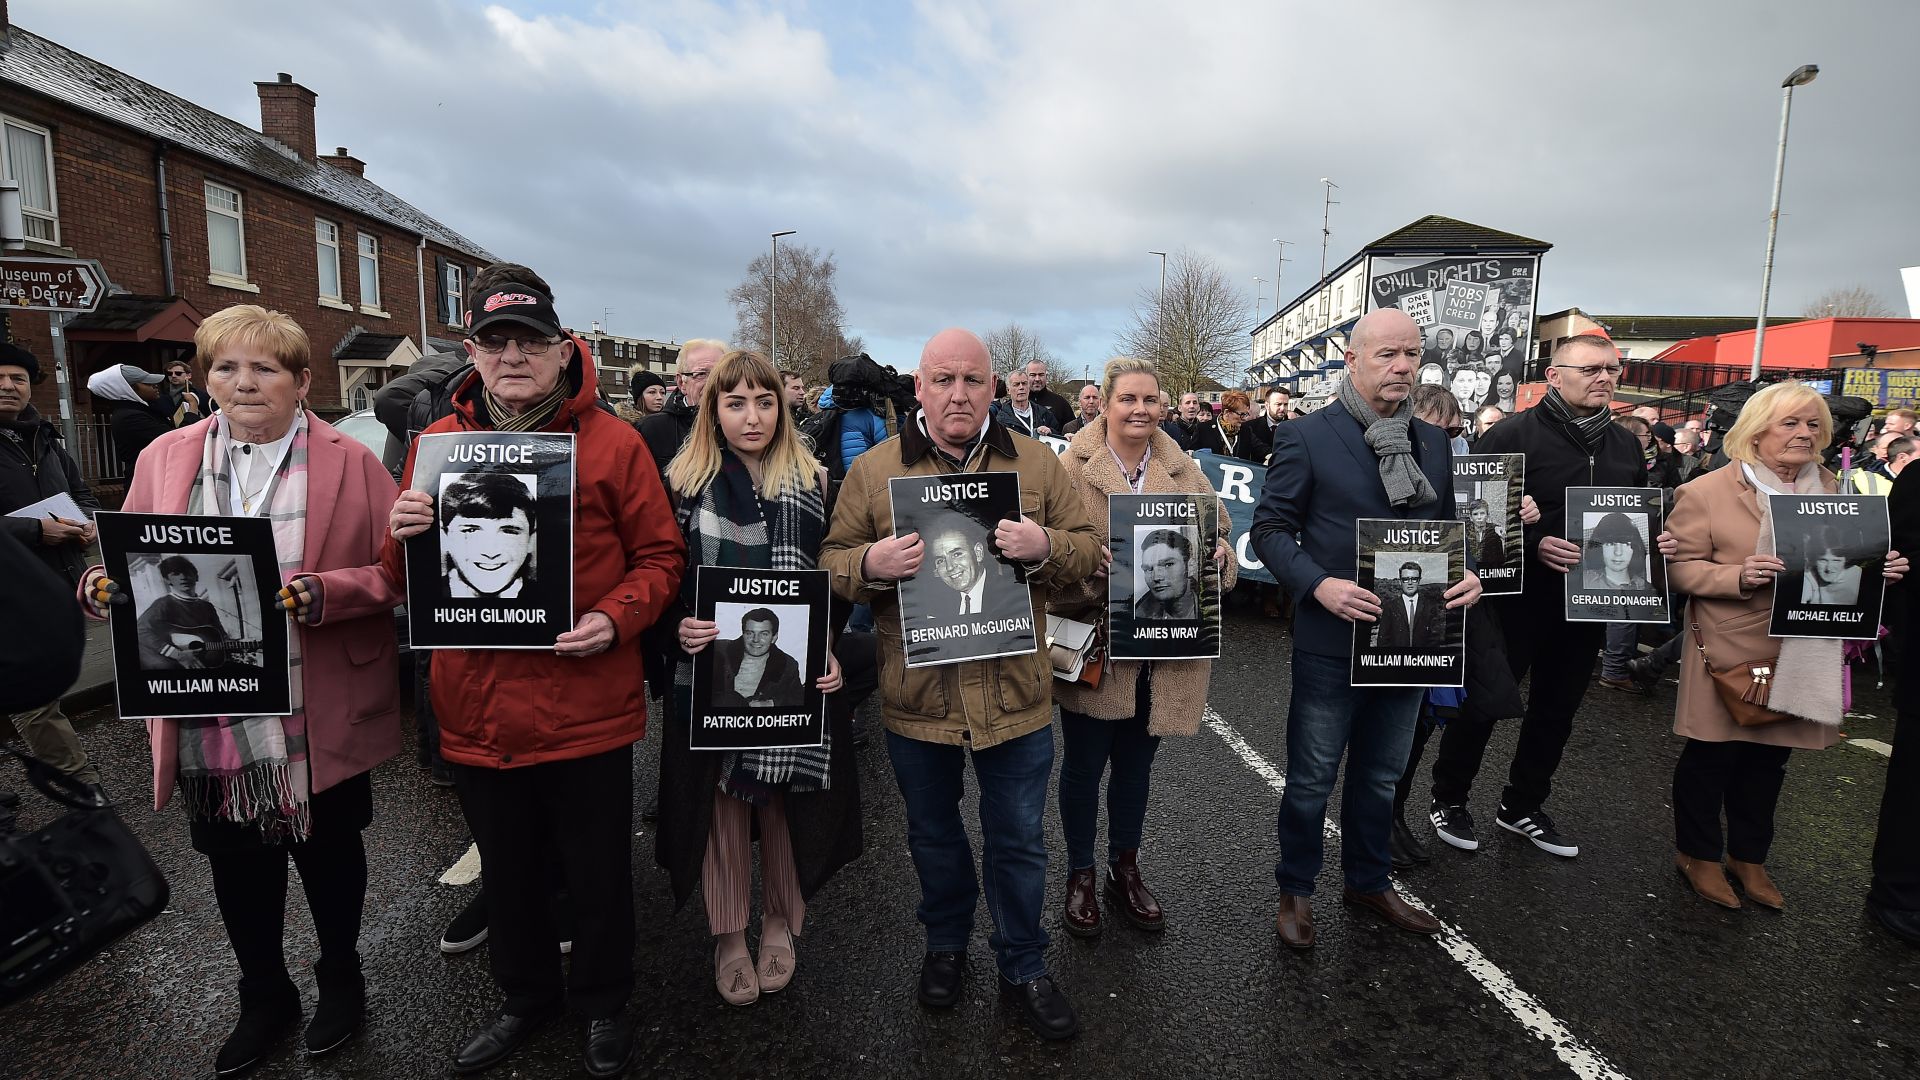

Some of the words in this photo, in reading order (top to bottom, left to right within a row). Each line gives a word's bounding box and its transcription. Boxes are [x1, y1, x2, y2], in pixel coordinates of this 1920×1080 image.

[0, 267, 52, 282] useum
[57, 270, 73, 283] of
[1375, 270, 1425, 297] CIVIL
[1427, 259, 1502, 289] RIGHTS
[31, 285, 73, 304] Derry
[1407, 293, 1429, 304] ONE
[1448, 284, 1485, 302] JOBS
[1407, 300, 1431, 312] MAN
[1450, 297, 1476, 311] NOT
[1410, 308, 1429, 319] ONE
[1415, 314, 1433, 326] OTE
[1445, 307, 1477, 321] CREED
[1846, 370, 1881, 384] FREE
[1842, 384, 1881, 395] DERRY
[447, 443, 533, 464] JUSTICE
[1453, 462, 1504, 476] JUSTICE
[920, 482, 989, 503] JUSTICE
[1590, 494, 1642, 507] JUSTICE
[1136, 502, 1196, 518] JUSTICE
[1796, 501, 1860, 516] JUSTICE
[139, 524, 234, 545] JUSTICE
[1383, 528, 1440, 545] JUSTICE
[1479, 567, 1517, 579] ELHINNEY
[728, 577, 800, 596] JUSTICE
[1571, 594, 1611, 605] GERALD
[1612, 595, 1663, 606] DONAGHEY
[434, 608, 477, 623] HUGH
[480, 608, 547, 624] GILMOUR
[1787, 610, 1831, 621] MICHAEL
[1832, 611, 1864, 623] KELLY
[911, 623, 969, 643] BERNARD
[971, 616, 1031, 636] McGUIGAN
[1133, 627, 1169, 639] JAMES
[1170, 627, 1199, 639] WRAY
[1360, 654, 1402, 667] WILLIAM
[1403, 655, 1456, 667] McKINNEY
[147, 678, 214, 694] WILLIAM
[217, 678, 259, 693] NASH
[703, 715, 754, 729] PATRICK
[756, 713, 812, 729] DOHERTY
